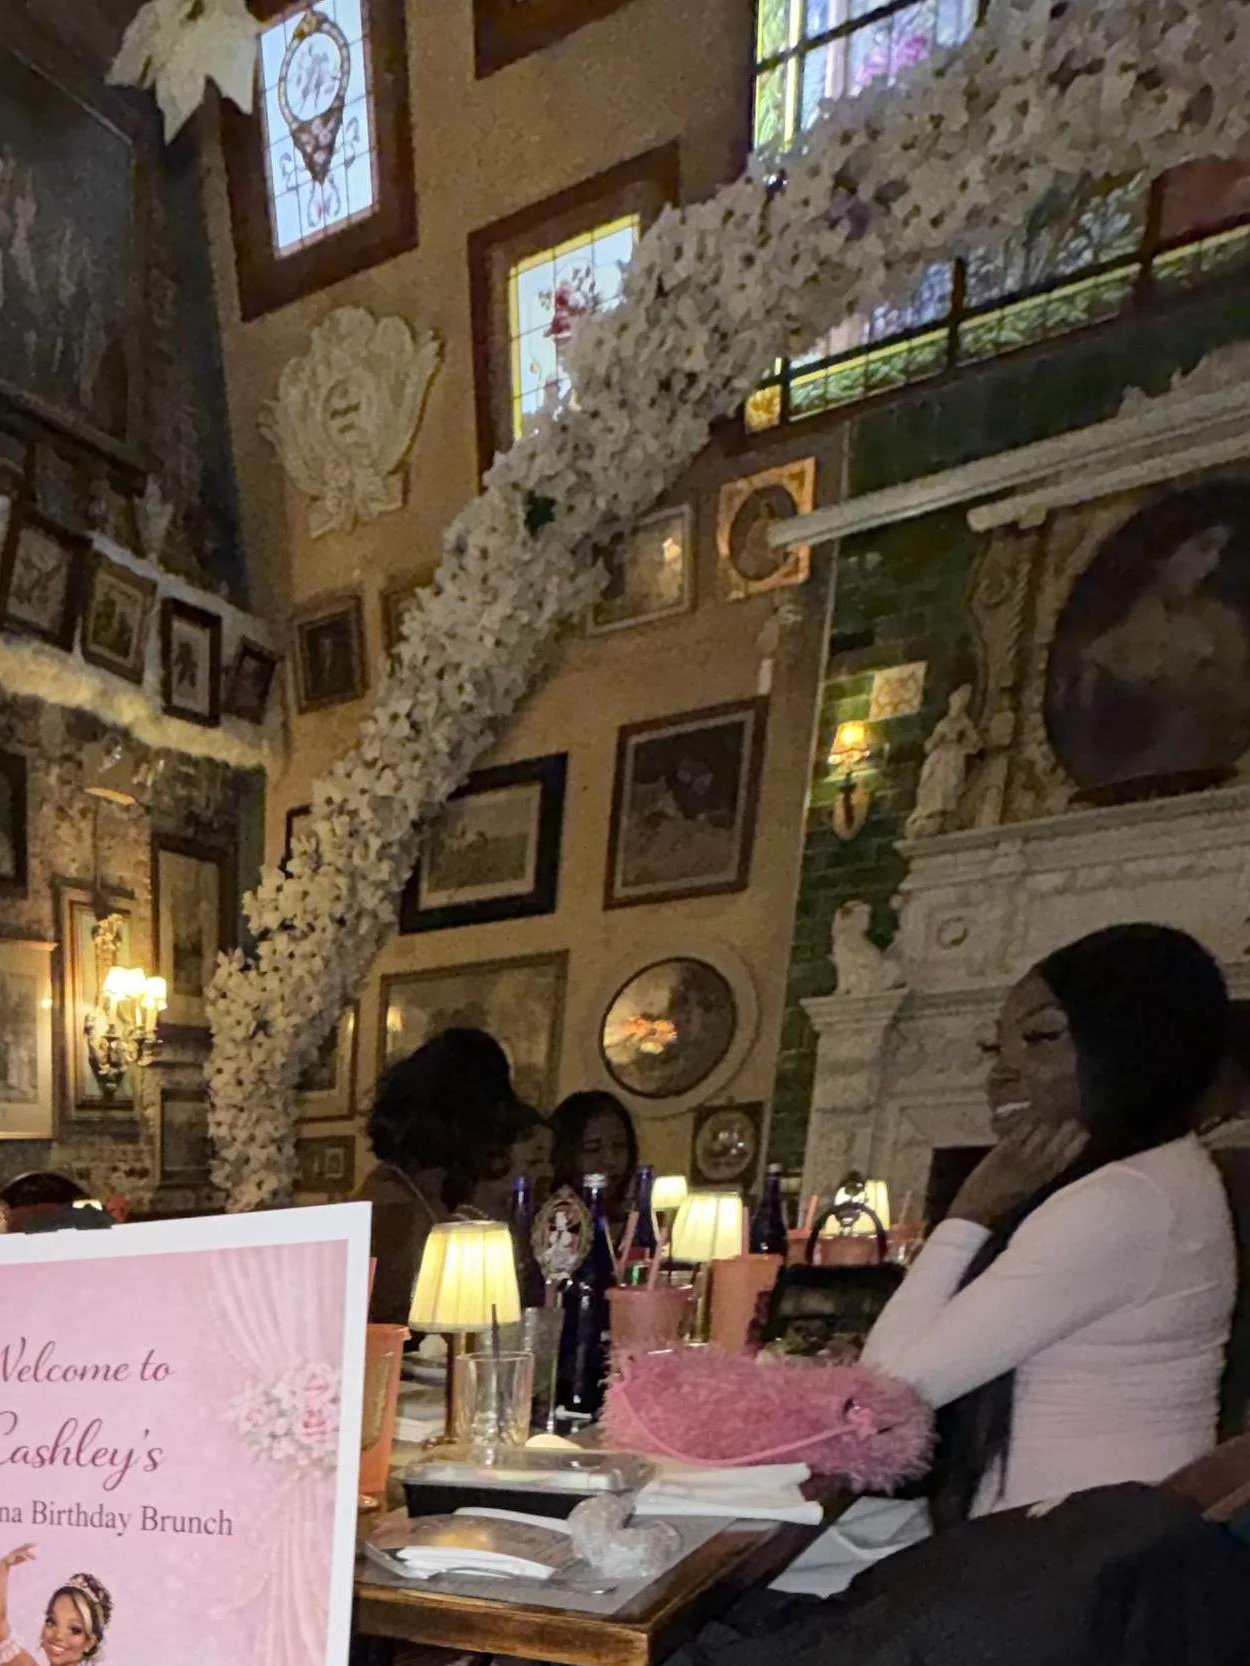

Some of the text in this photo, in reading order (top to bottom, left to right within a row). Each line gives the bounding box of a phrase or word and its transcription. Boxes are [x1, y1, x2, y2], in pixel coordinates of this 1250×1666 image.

[139, 1348, 175, 1382] to
[31, 1499, 132, 1537] Birthday
[140, 1505, 234, 1536] Brunch
